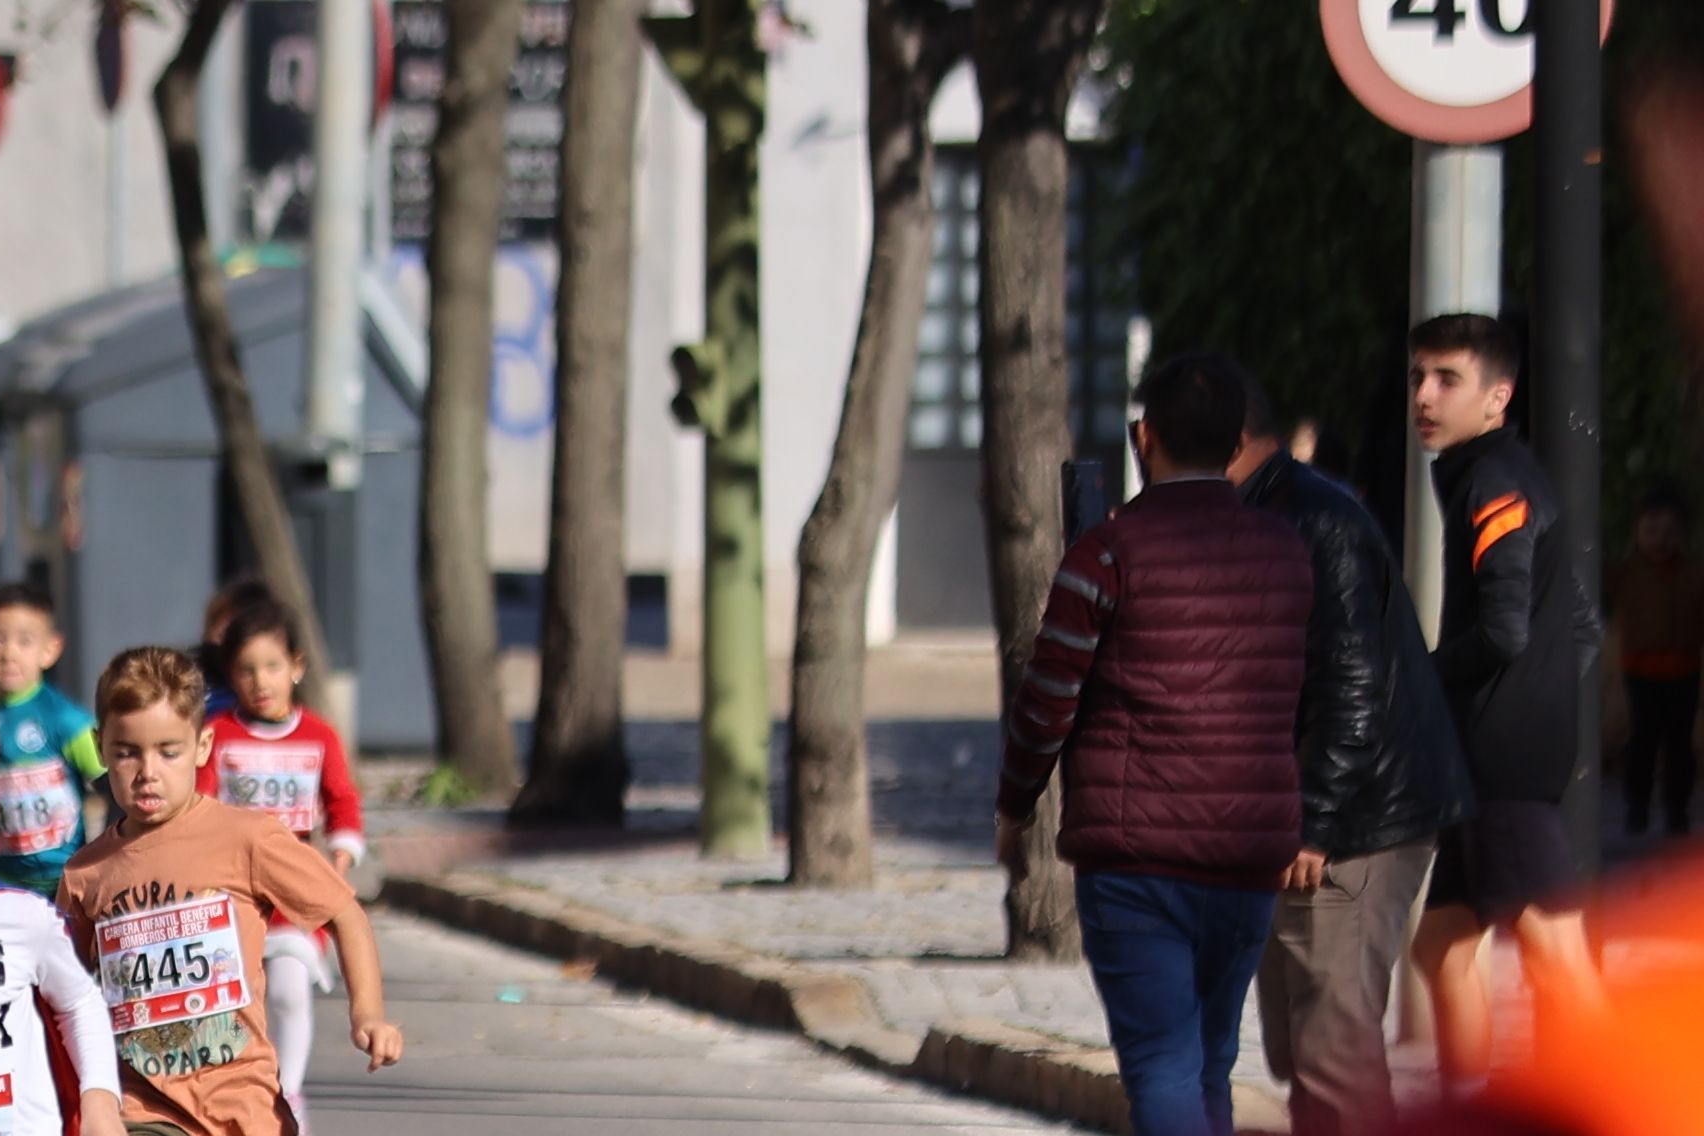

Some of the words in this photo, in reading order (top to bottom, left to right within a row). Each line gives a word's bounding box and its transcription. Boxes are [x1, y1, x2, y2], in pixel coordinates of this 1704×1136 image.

[243, 777, 299, 807] 299
[119, 930, 167, 949] BOMBEROS
[168, 926, 179, 940] DE
[181, 920, 210, 938] JEREZ
[141, 914, 180, 933] INFANTIL
[130, 942, 210, 993] 445
[126, 1043, 234, 1077] OPARD
